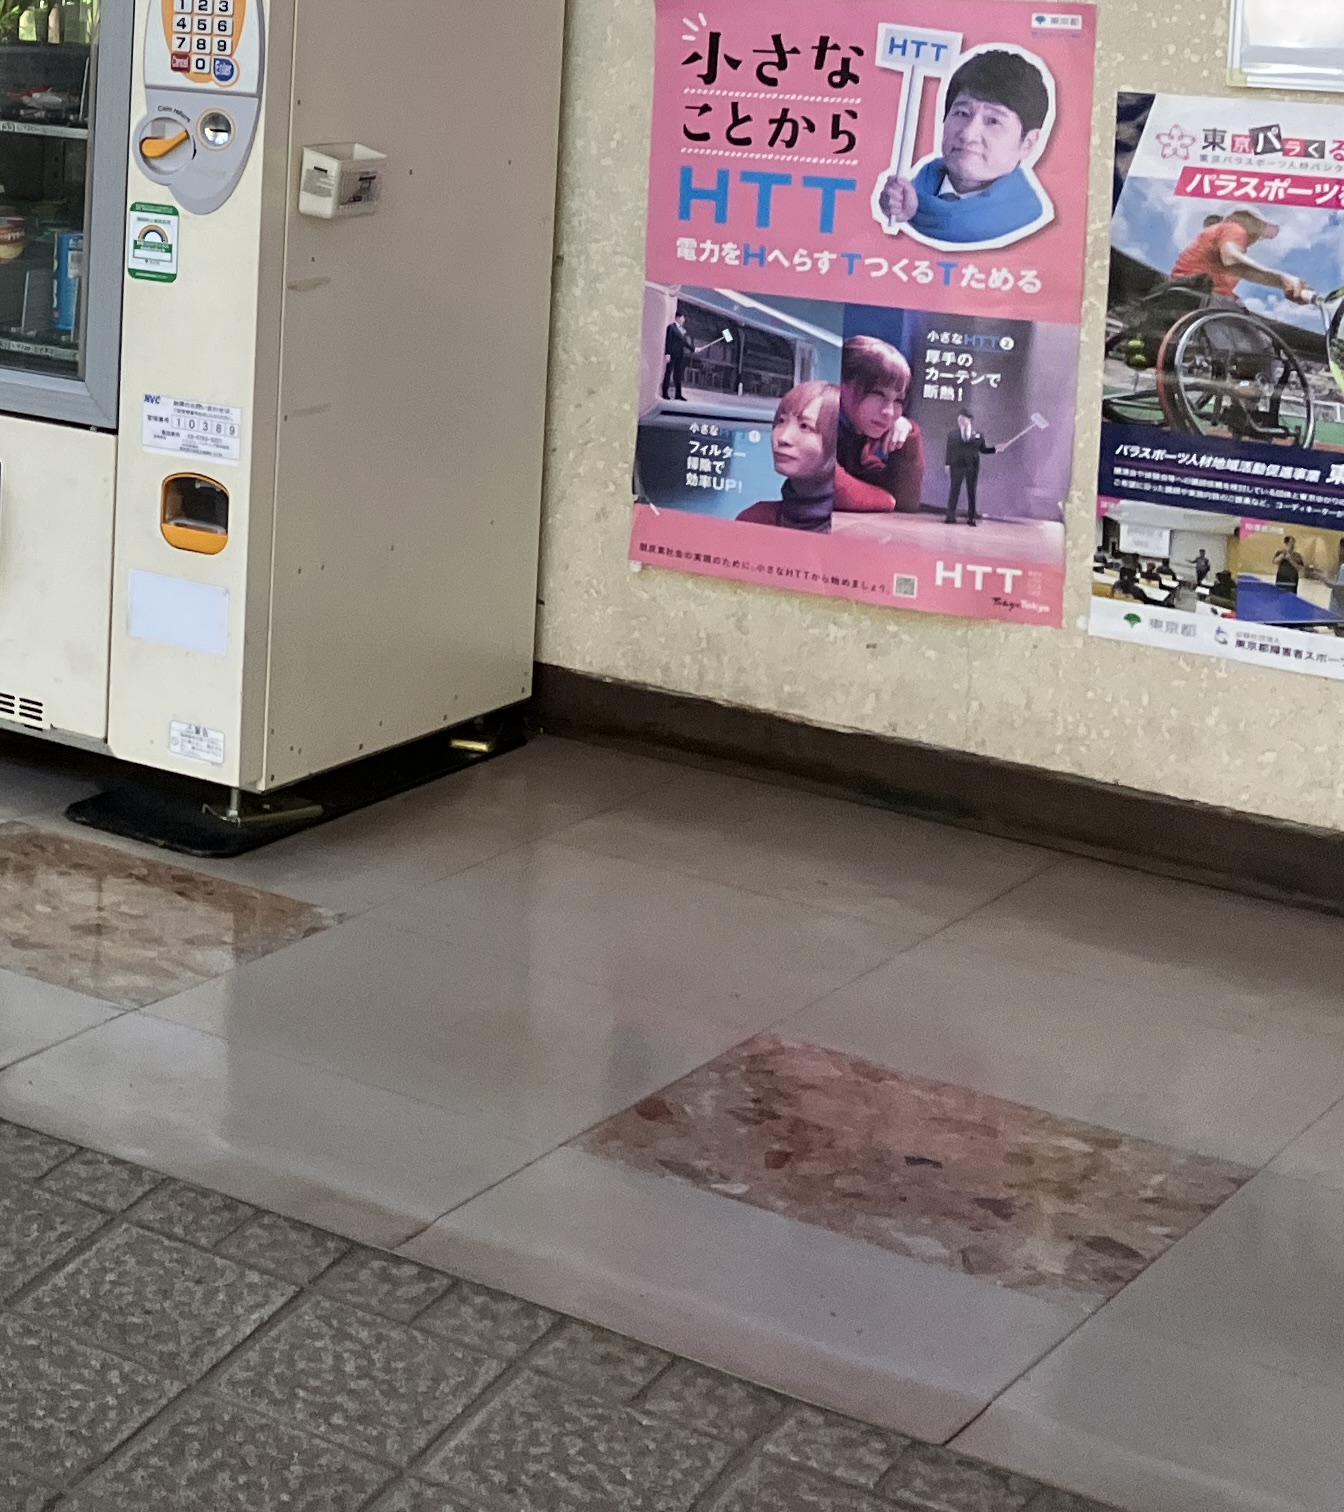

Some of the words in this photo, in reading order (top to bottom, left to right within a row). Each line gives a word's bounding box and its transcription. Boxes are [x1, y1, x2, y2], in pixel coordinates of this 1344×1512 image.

[198, 0, 208, 11] 2
[218, 0, 229, 13] 3
[176, 17, 187, 29] 4
[197, 18, 207, 31] 5
[217, 20, 228, 32] 6
[176, 37, 186, 49] 7
[196, 38, 206, 50] 8
[217, 39, 227, 52] 9
[887, 36, 948, 62] HTT
[195, 58, 206, 70] 0
[680, 31, 865, 89] 小さな
[682, 101, 860, 155] ことから
[1186, 173, 1344, 205] パラスポーツ
[678, 165, 858, 235] HTT
[925, 349, 973, 368] 厚手の
[924, 369, 1002, 388] カーテンで
[687, 441, 747, 459] フィルター
[935, 561, 1022, 594] HTT
[1235, 639, 1344, 667] 東京都障害者スポー
